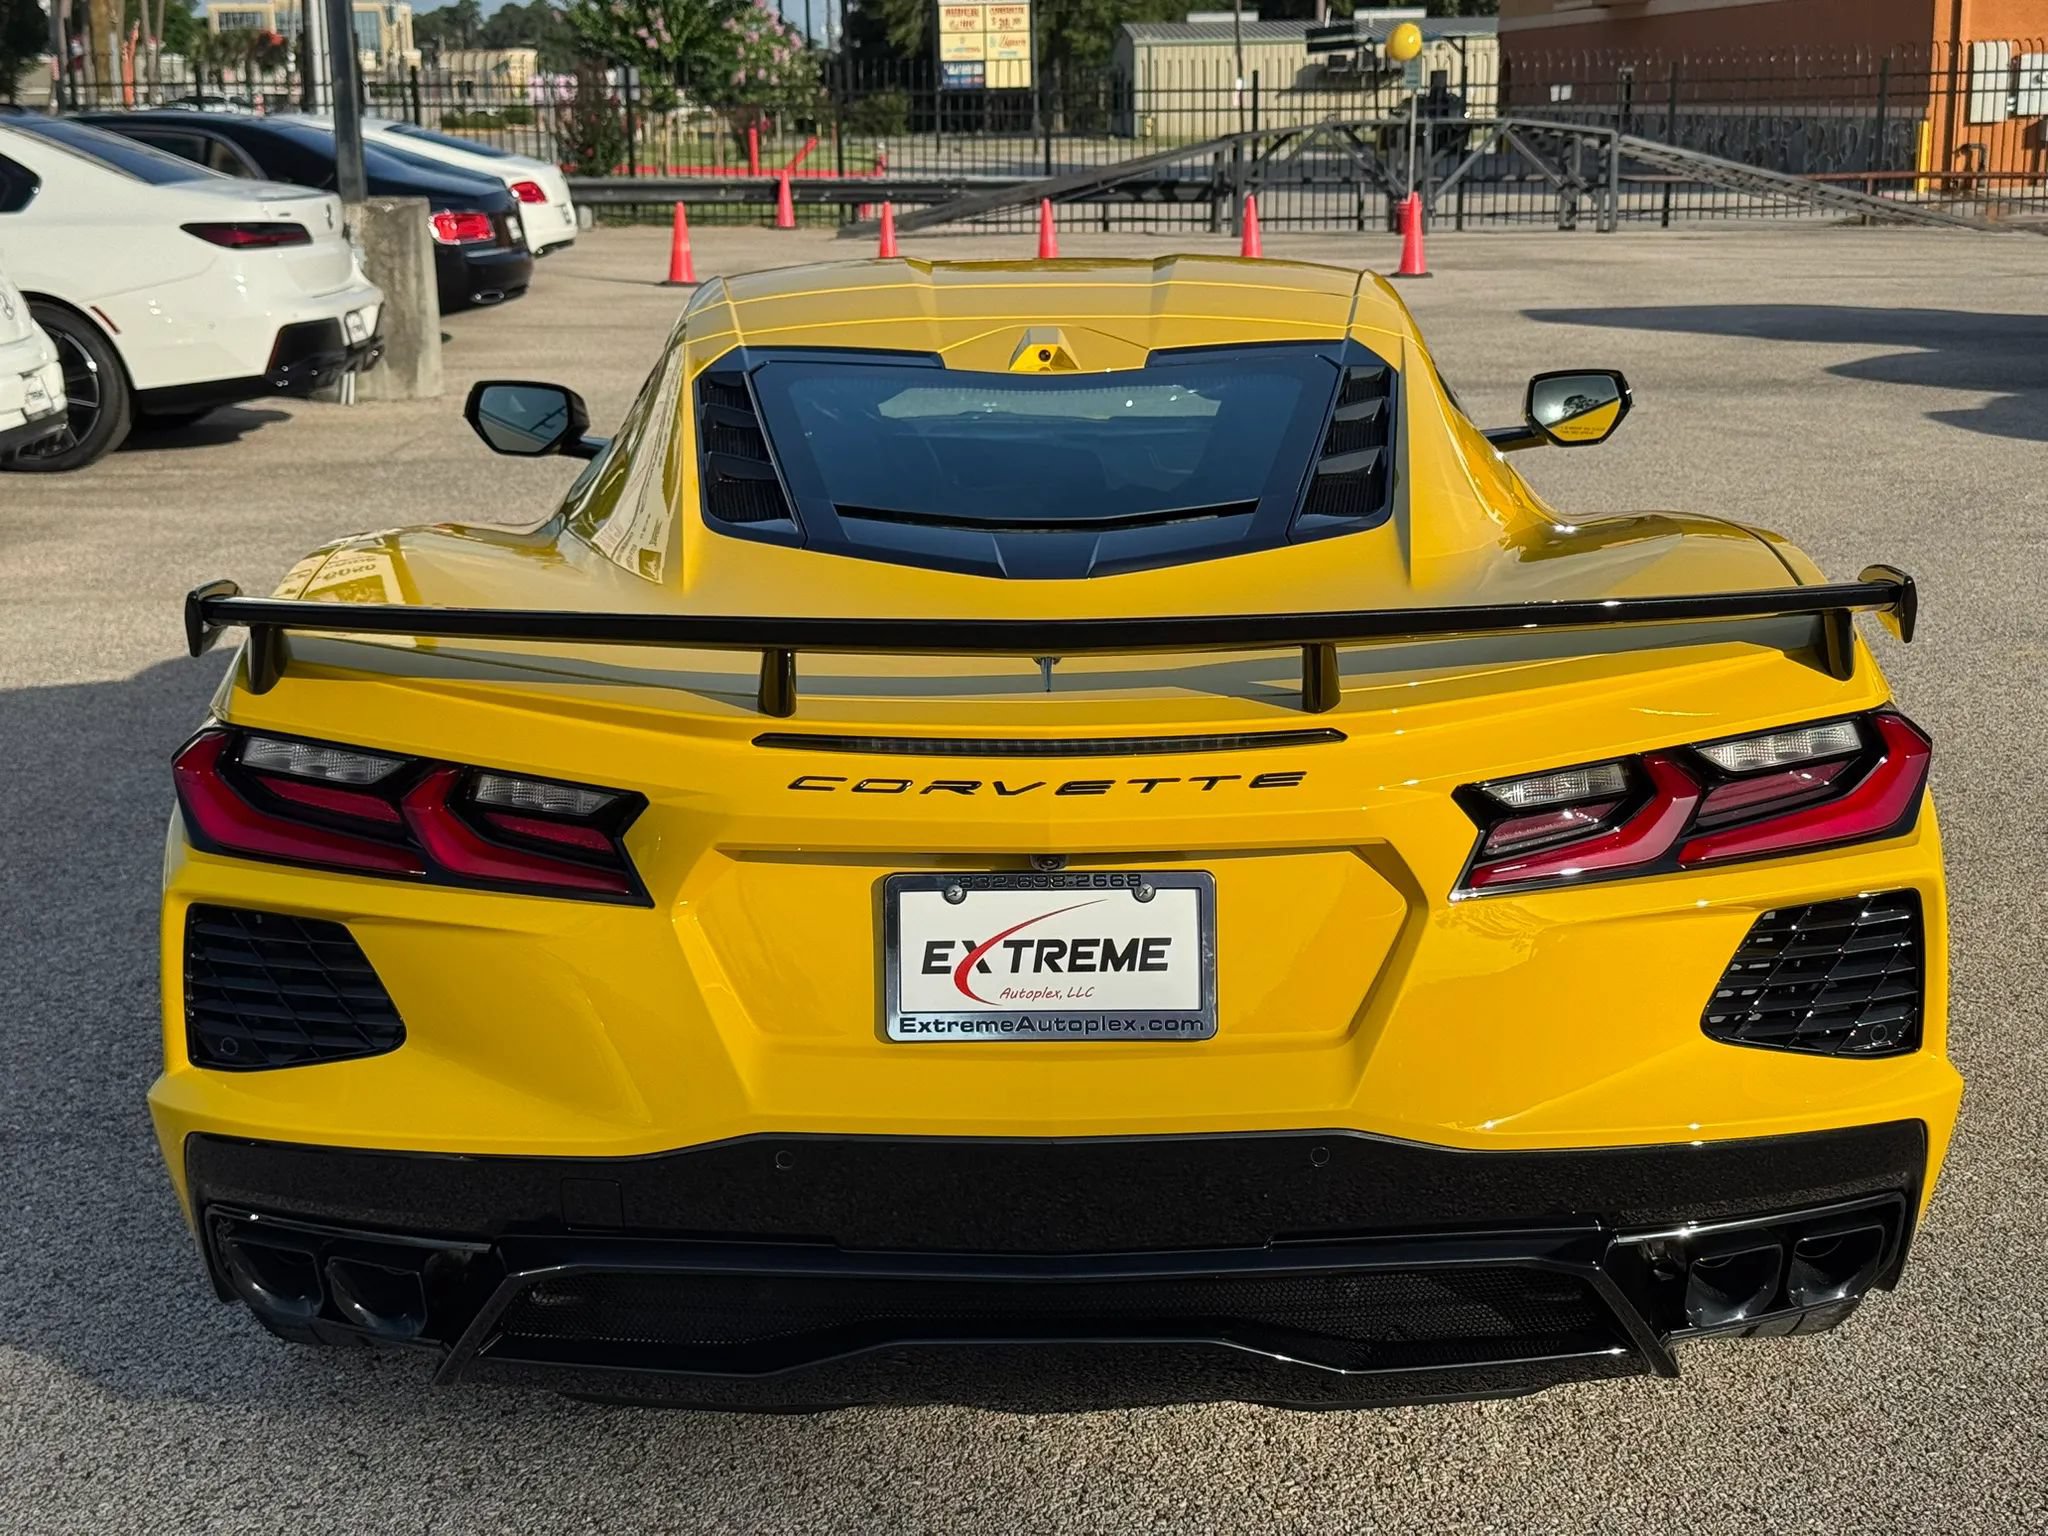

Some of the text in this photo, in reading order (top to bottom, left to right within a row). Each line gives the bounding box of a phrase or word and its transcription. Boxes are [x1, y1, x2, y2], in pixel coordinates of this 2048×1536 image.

[787, 770, 1308, 796] CORVETTE
[921, 937, 1171, 975] EXTREME
[1000, 987, 1095, 1001] Autoplex, LLC
[899, 1015, 1205, 1035] ExtremeAutoplex.com
